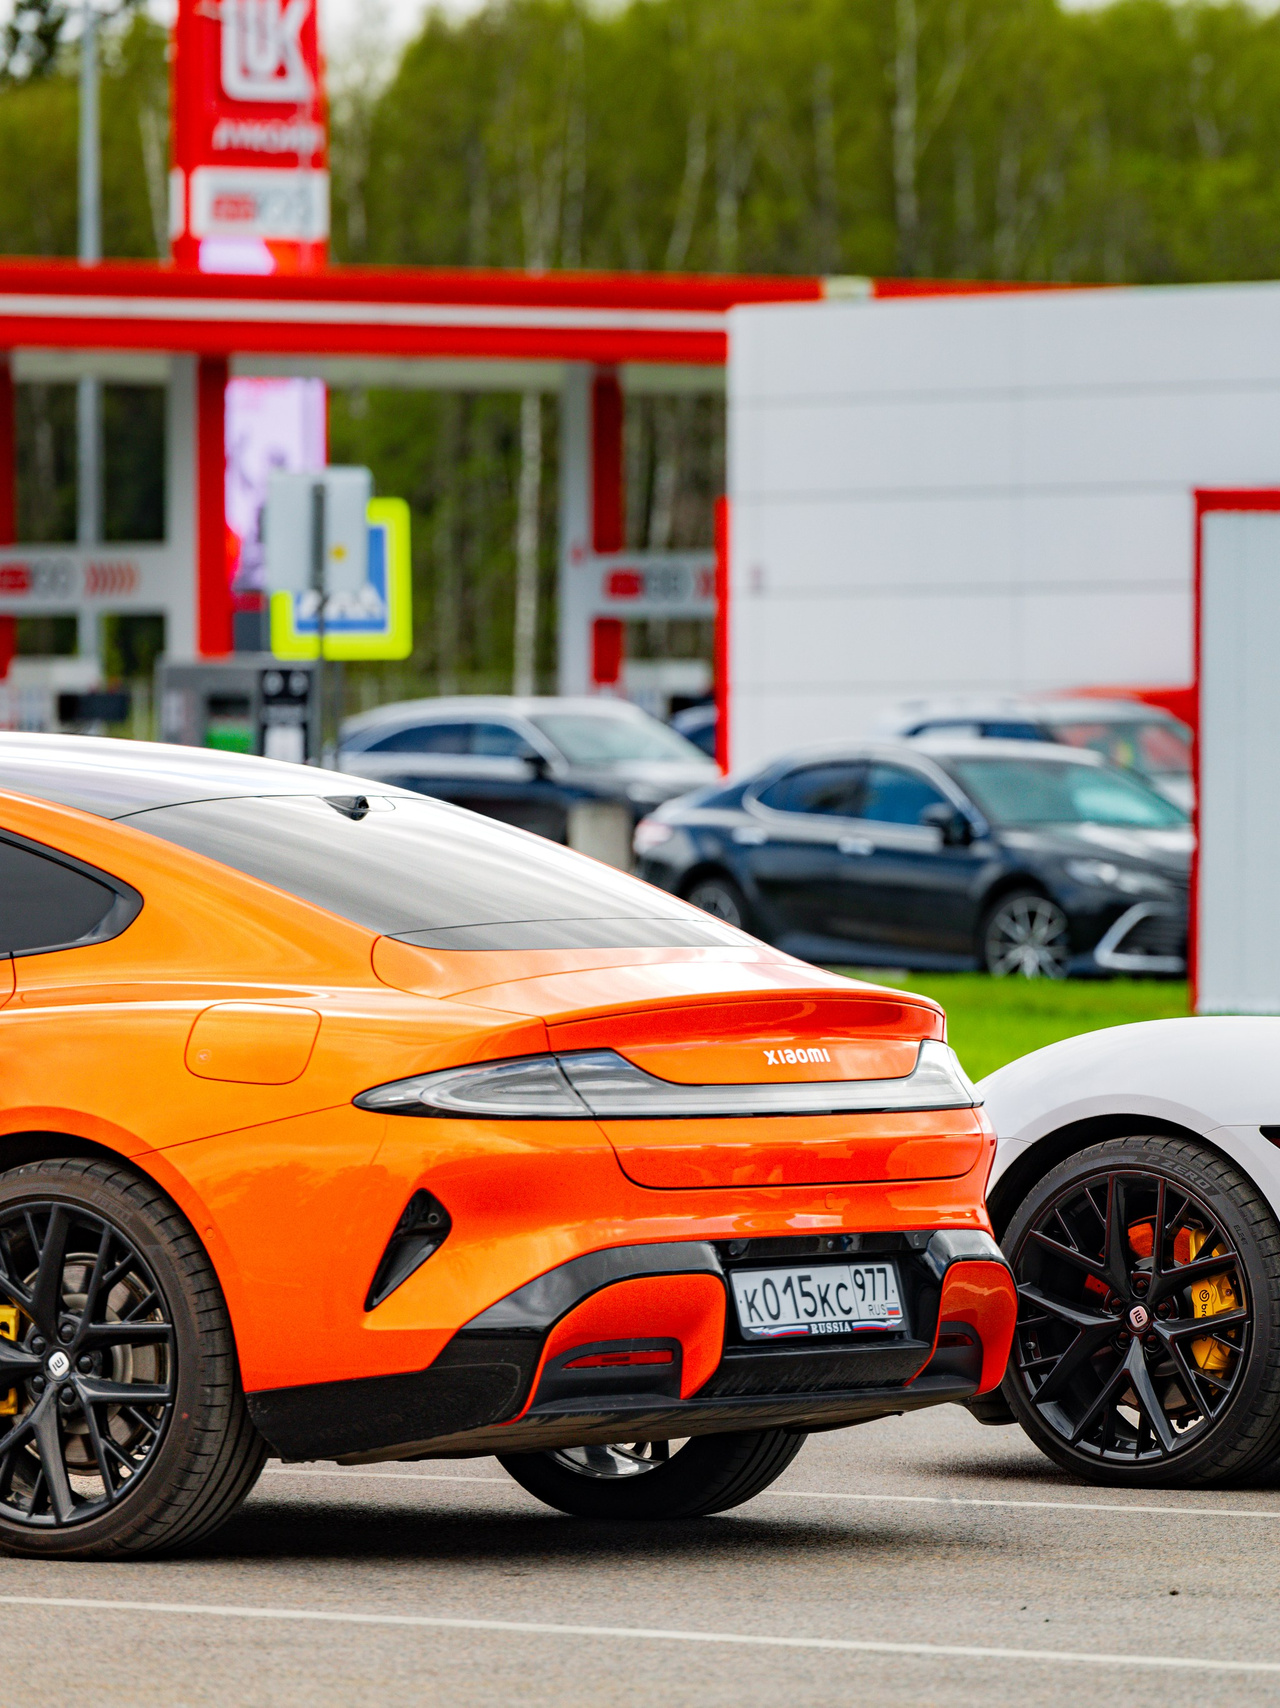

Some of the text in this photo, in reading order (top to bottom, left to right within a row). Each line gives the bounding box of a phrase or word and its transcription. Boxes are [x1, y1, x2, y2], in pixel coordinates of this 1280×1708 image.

[853, 1267, 888, 1302] 977
[868, 1304, 887, 1316] RUS
[810, 1321, 852, 1335] RUSSIA
